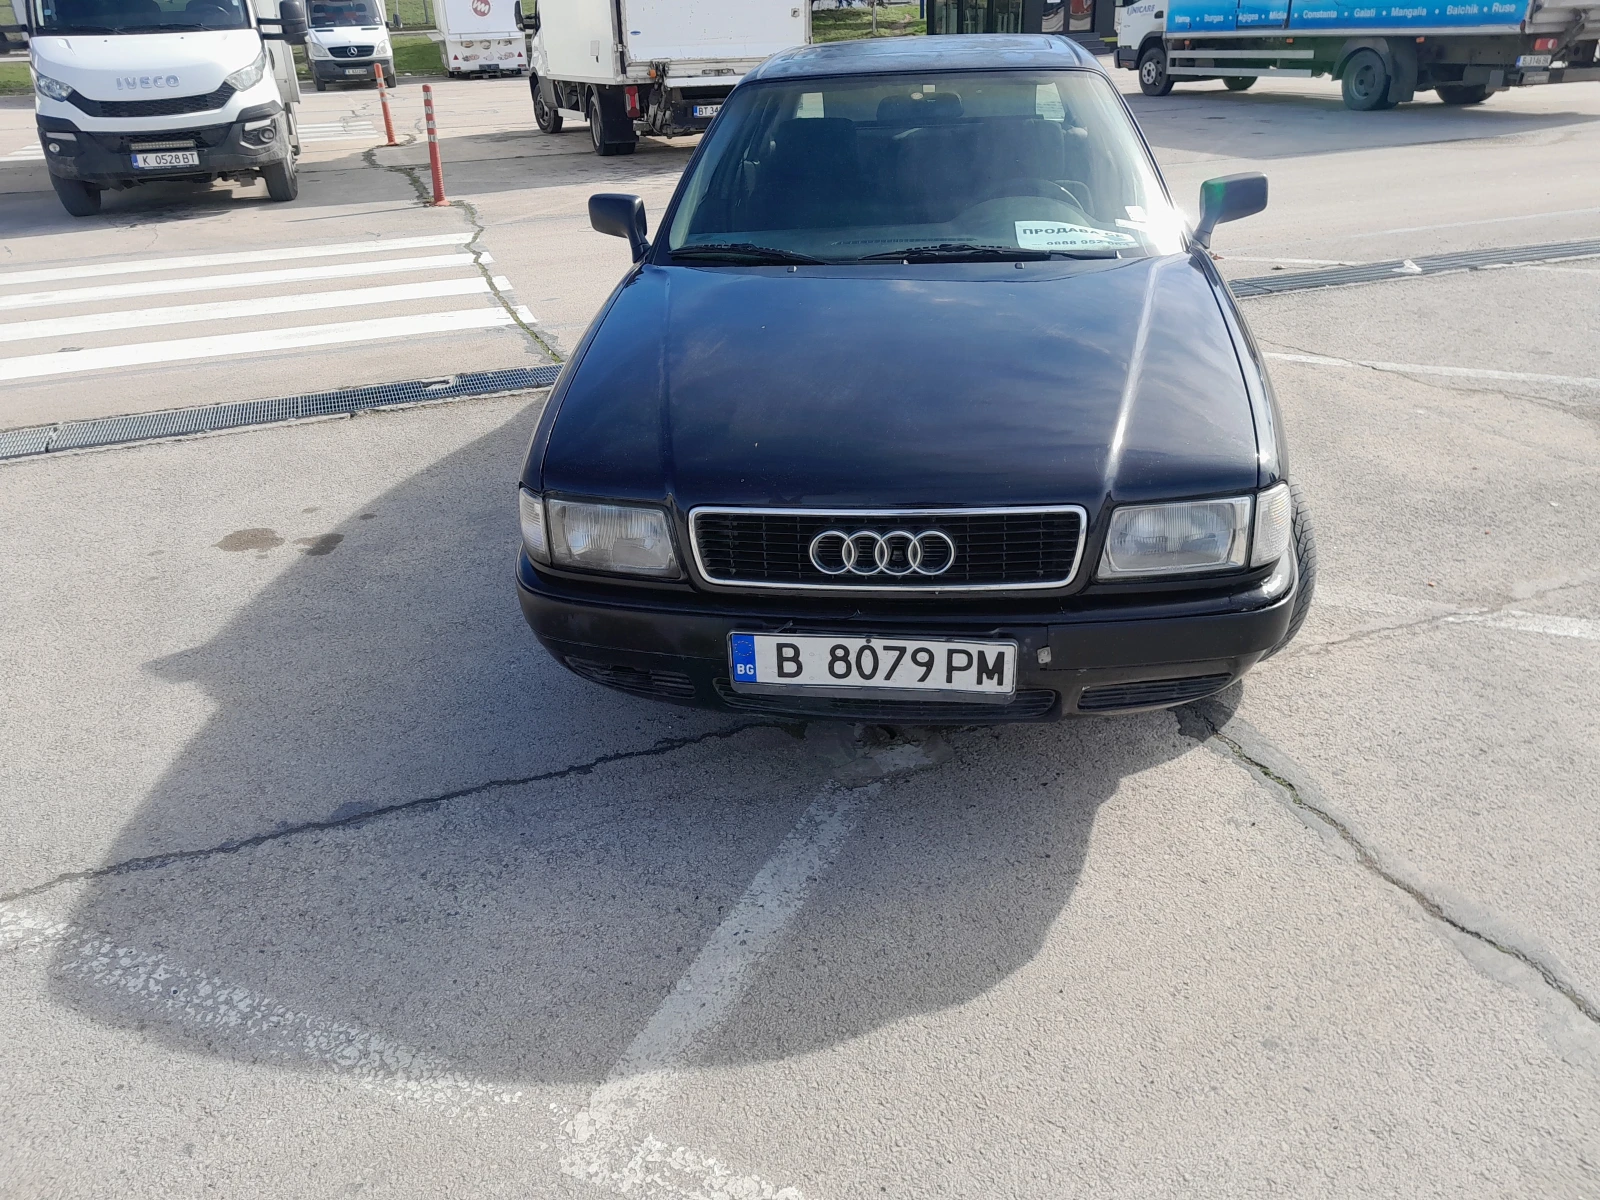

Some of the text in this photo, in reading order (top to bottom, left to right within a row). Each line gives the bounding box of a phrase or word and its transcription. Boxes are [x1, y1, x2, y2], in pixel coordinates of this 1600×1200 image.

[1127, 4, 1156, 16] UNICARE
[1204, 14, 1224, 23] Burgas
[1303, 10, 1338, 19] Constanta
[1354, 8, 1376, 17] Galati
[1391, 6, 1427, 18] Mangalia
[1447, 4, 1479, 15] Balchik
[1492, 2, 1516, 13] Ruse
[116, 75, 180, 90] IVECO
[142, 155, 150, 166] K
[1023, 227, 1100, 235] ПРОДАВА
[736, 663, 755, 675] BG
[776, 642, 802, 678] B
